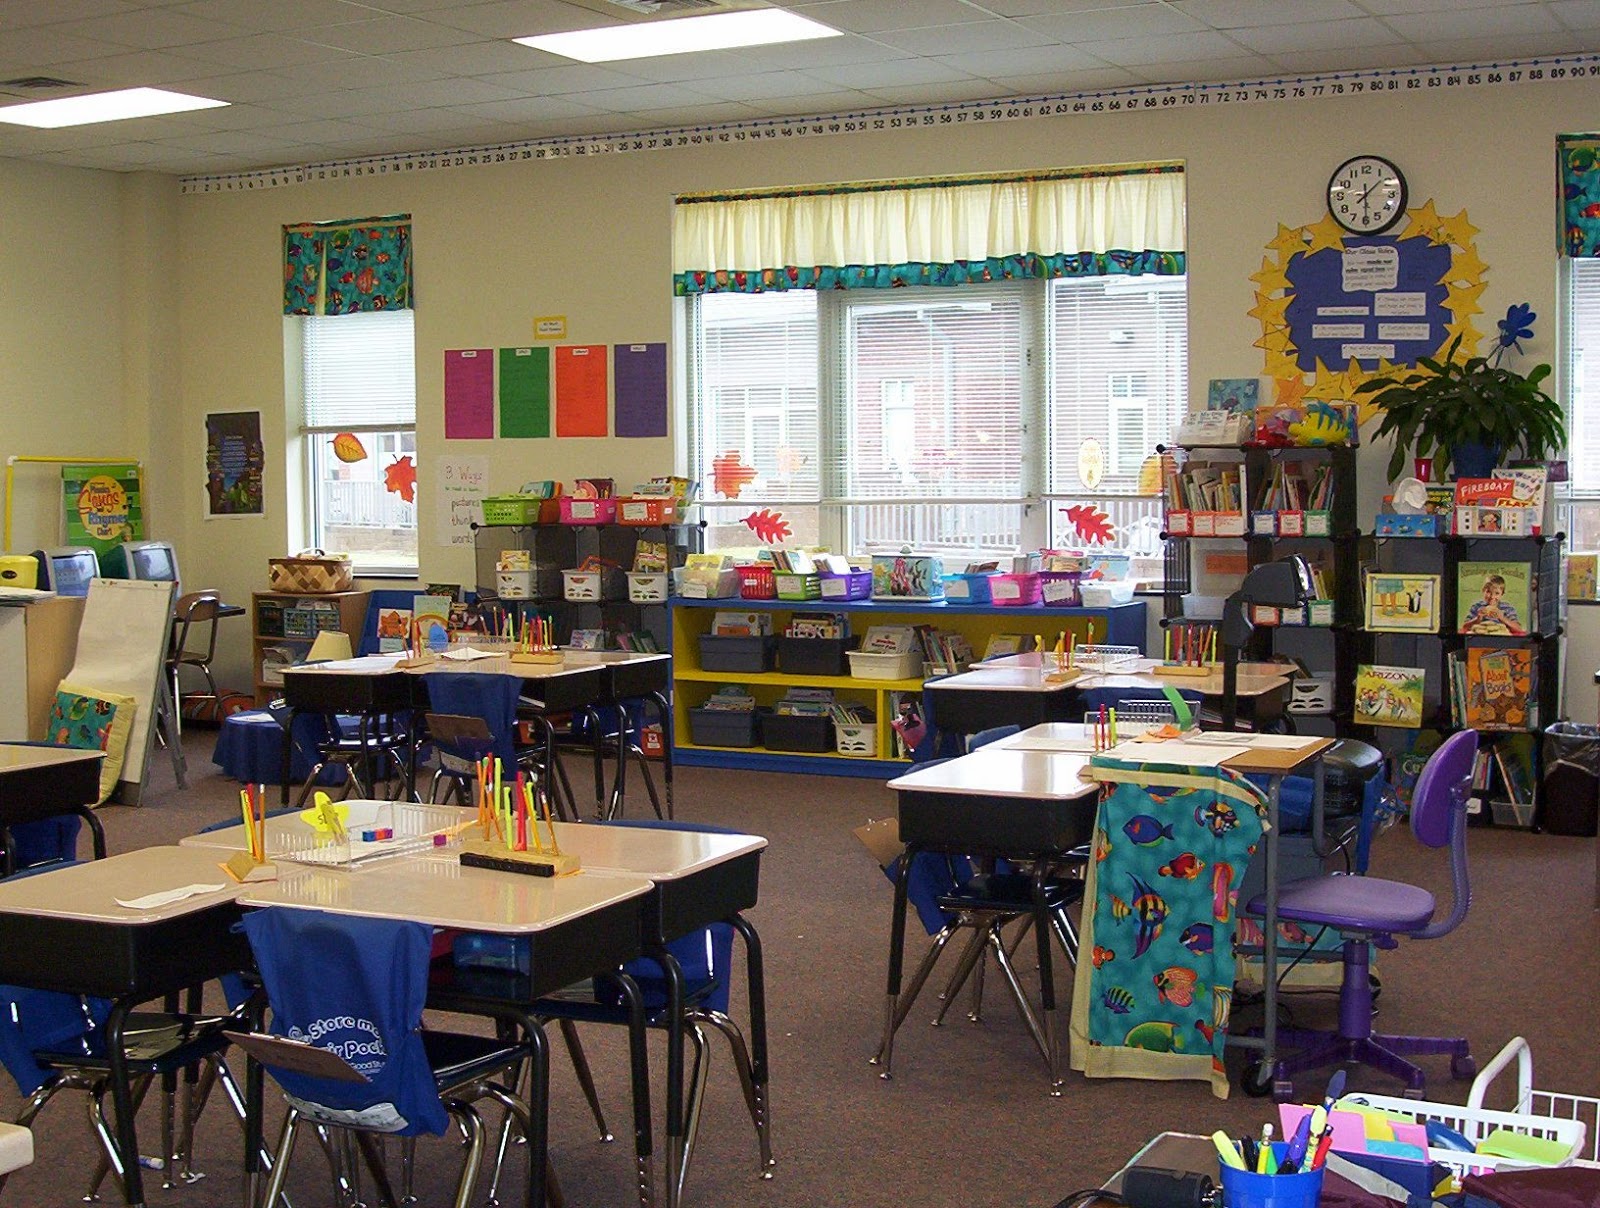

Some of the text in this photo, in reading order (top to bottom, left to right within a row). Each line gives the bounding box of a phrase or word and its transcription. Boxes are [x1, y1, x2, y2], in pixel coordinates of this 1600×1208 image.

[764, 128, 776, 138] 45
[780, 127, 793, 137] 46
[796, 126, 808, 135] 47
[812, 125, 824, 134] 48
[828, 123, 841, 133] 49
[844, 122, 856, 132] 50
[859, 121, 867, 131] 51
[873, 119, 885, 129] 52
[890, 118, 902, 128] 53
[906, 116, 918, 127] 54
[923, 115, 935, 126] 55
[940, 114, 952, 124] 56
[957, 112, 968, 123] 57
[973, 111, 985, 121] 58
[990, 109, 1003, 120] 59
[1007, 108, 1019, 118] 60
[1022, 107, 1033, 117] 61
[1039, 105, 1051, 115] 62
[1055, 103, 1068, 114] 63
[1072, 102, 1086, 112] 64
[1091, 101, 1104, 112] 65
[1108, 100, 1121, 111] 66
[1126, 98, 1139, 109] 67
[1143, 97, 1157, 108] 68
[1162, 95, 1177, 106] 69
[1181, 94, 1194, 105] 70
[1199, 93, 1209, 104] 71
[1217, 92, 1230, 103] 72
[1235, 91, 1249, 101] 73
[1255, 89, 1268, 100] 74
[1273, 88, 1287, 99] 75
[1292, 87, 1306, 98] 76
[1312, 85, 1325, 96] 77
[1331, 83, 1345, 94] 78
[1350, 82, 1364, 93] 79
[1370, 80, 1384, 91] 80
[1387, 80, 1399, 90] 81
[1406, 78, 1421, 89] 82
[1427, 76, 1442, 88] 83
[1447, 75, 1461, 87] 84
[1467, 74, 1482, 85] 85
[1487, 72, 1502, 84] 86
[1509, 70, 1523, 82] 87
[1528, 69, 1544, 80] 88
[1550, 67, 1566, 79] 89
[1570, 66, 1586, 77] 90
[1589, 65, 1600, 76] 91
[1350, 169, 1358, 178] 11
[1361, 165, 1372, 175] 12
[1378, 168, 1382, 177] 1
[1388, 190, 1396, 198] 3
[1341, 204, 1349, 213] 8
[1350, 212, 1357, 221] 7
[1362, 215, 1370, 225] 6
[1374, 211, 1382, 220] 5
[445, 465, 453, 480] 3
[1365, 671, 1419, 682] ARIZONA
[1486, 670, 1509, 682] About
[308, 1016, 356, 1040] Store
